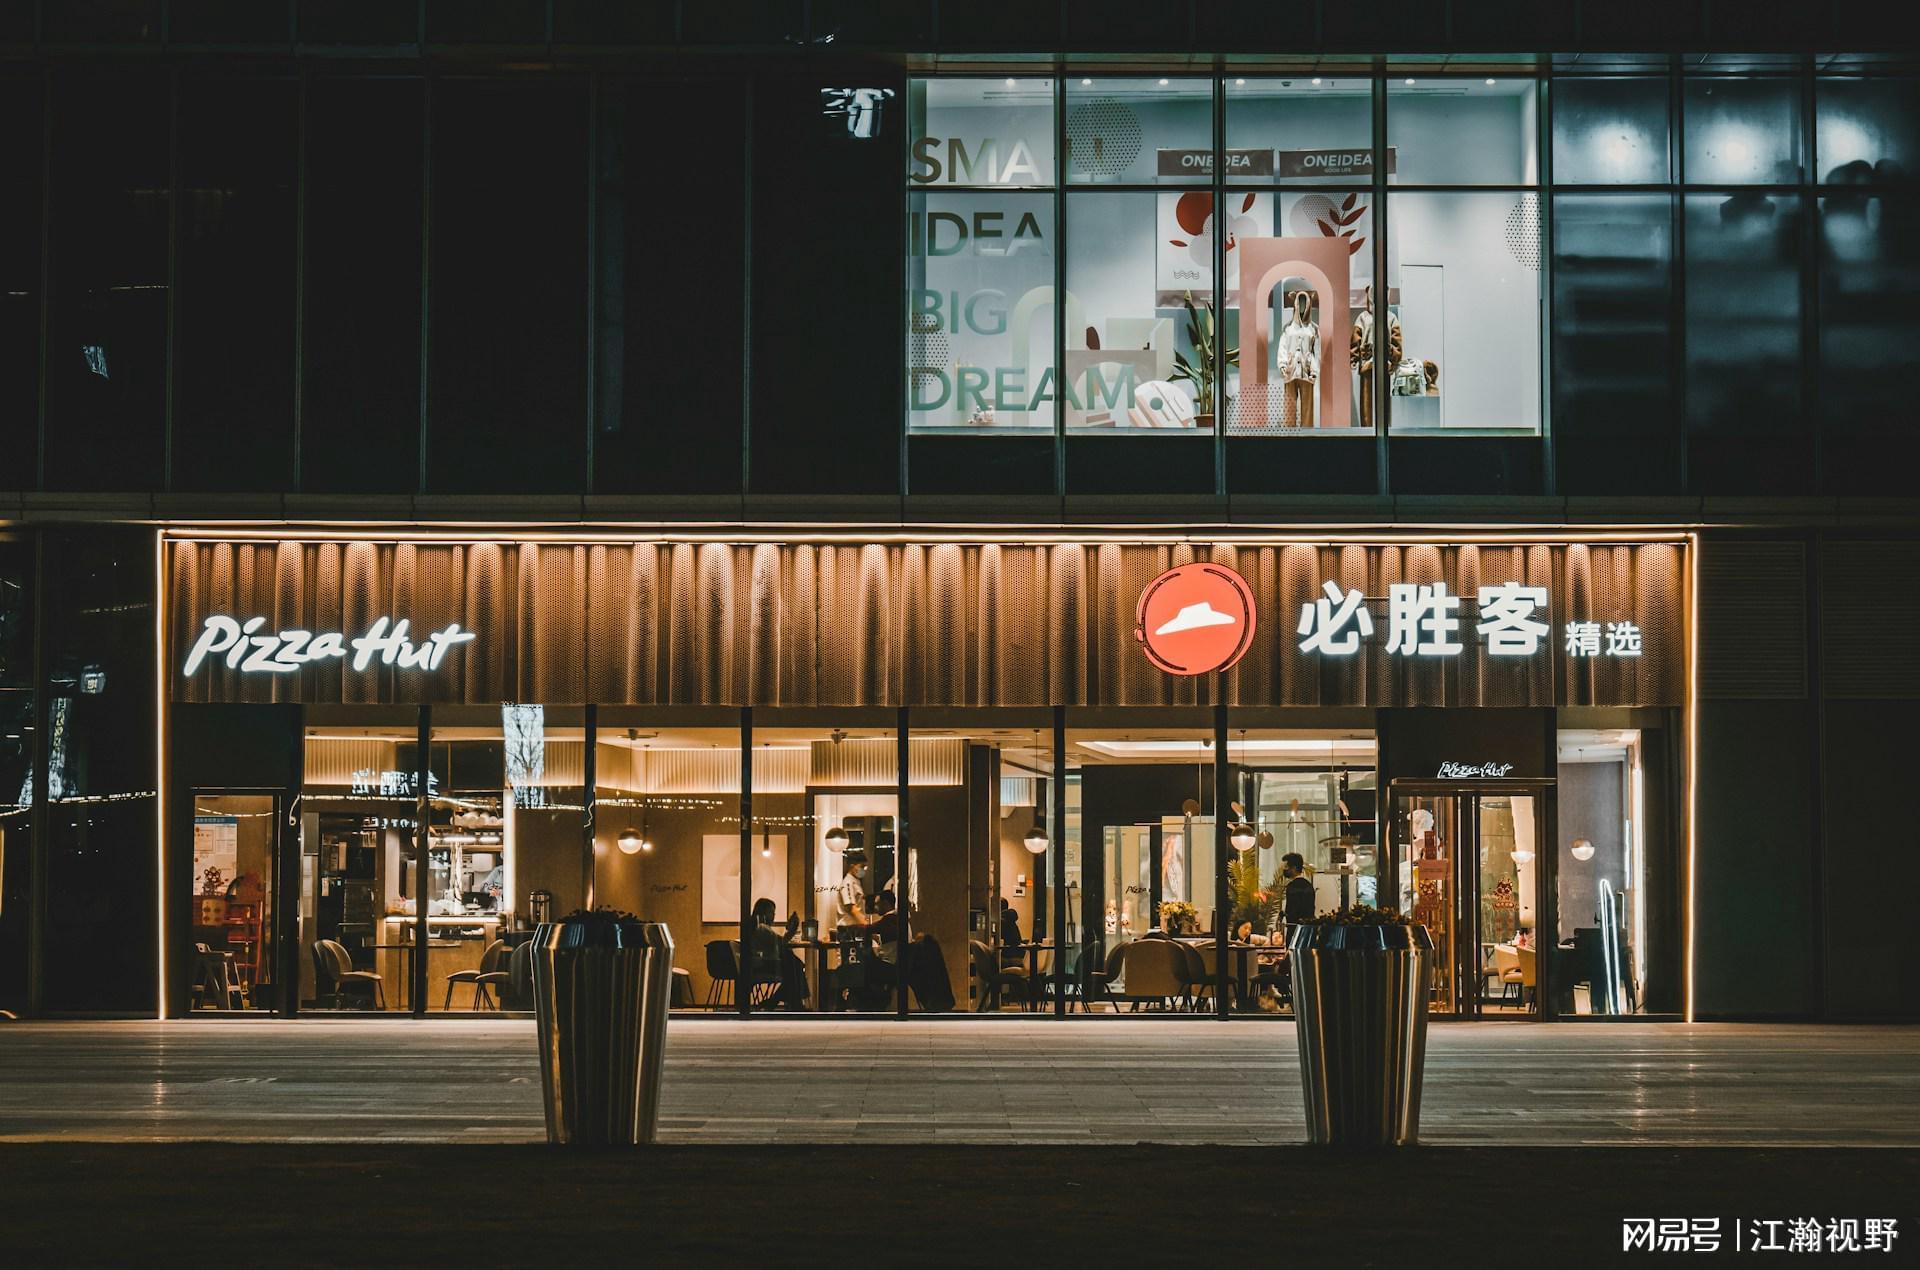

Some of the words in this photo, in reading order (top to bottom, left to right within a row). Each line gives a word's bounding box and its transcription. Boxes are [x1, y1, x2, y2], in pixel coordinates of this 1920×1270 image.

[1303, 153, 1373, 168] ONEIDEA
[910, 212, 1050, 257] IDEA
[910, 289, 1007, 336] BIG
[1297, 579, 1550, 656] 必胜客
[1565, 621, 1643, 656] 精选
[183, 615, 347, 677] Pizza
[351, 616, 476, 671] Hut
[1437, 761, 1480, 778] Pizza
[1480, 762, 1513, 777] Hut
